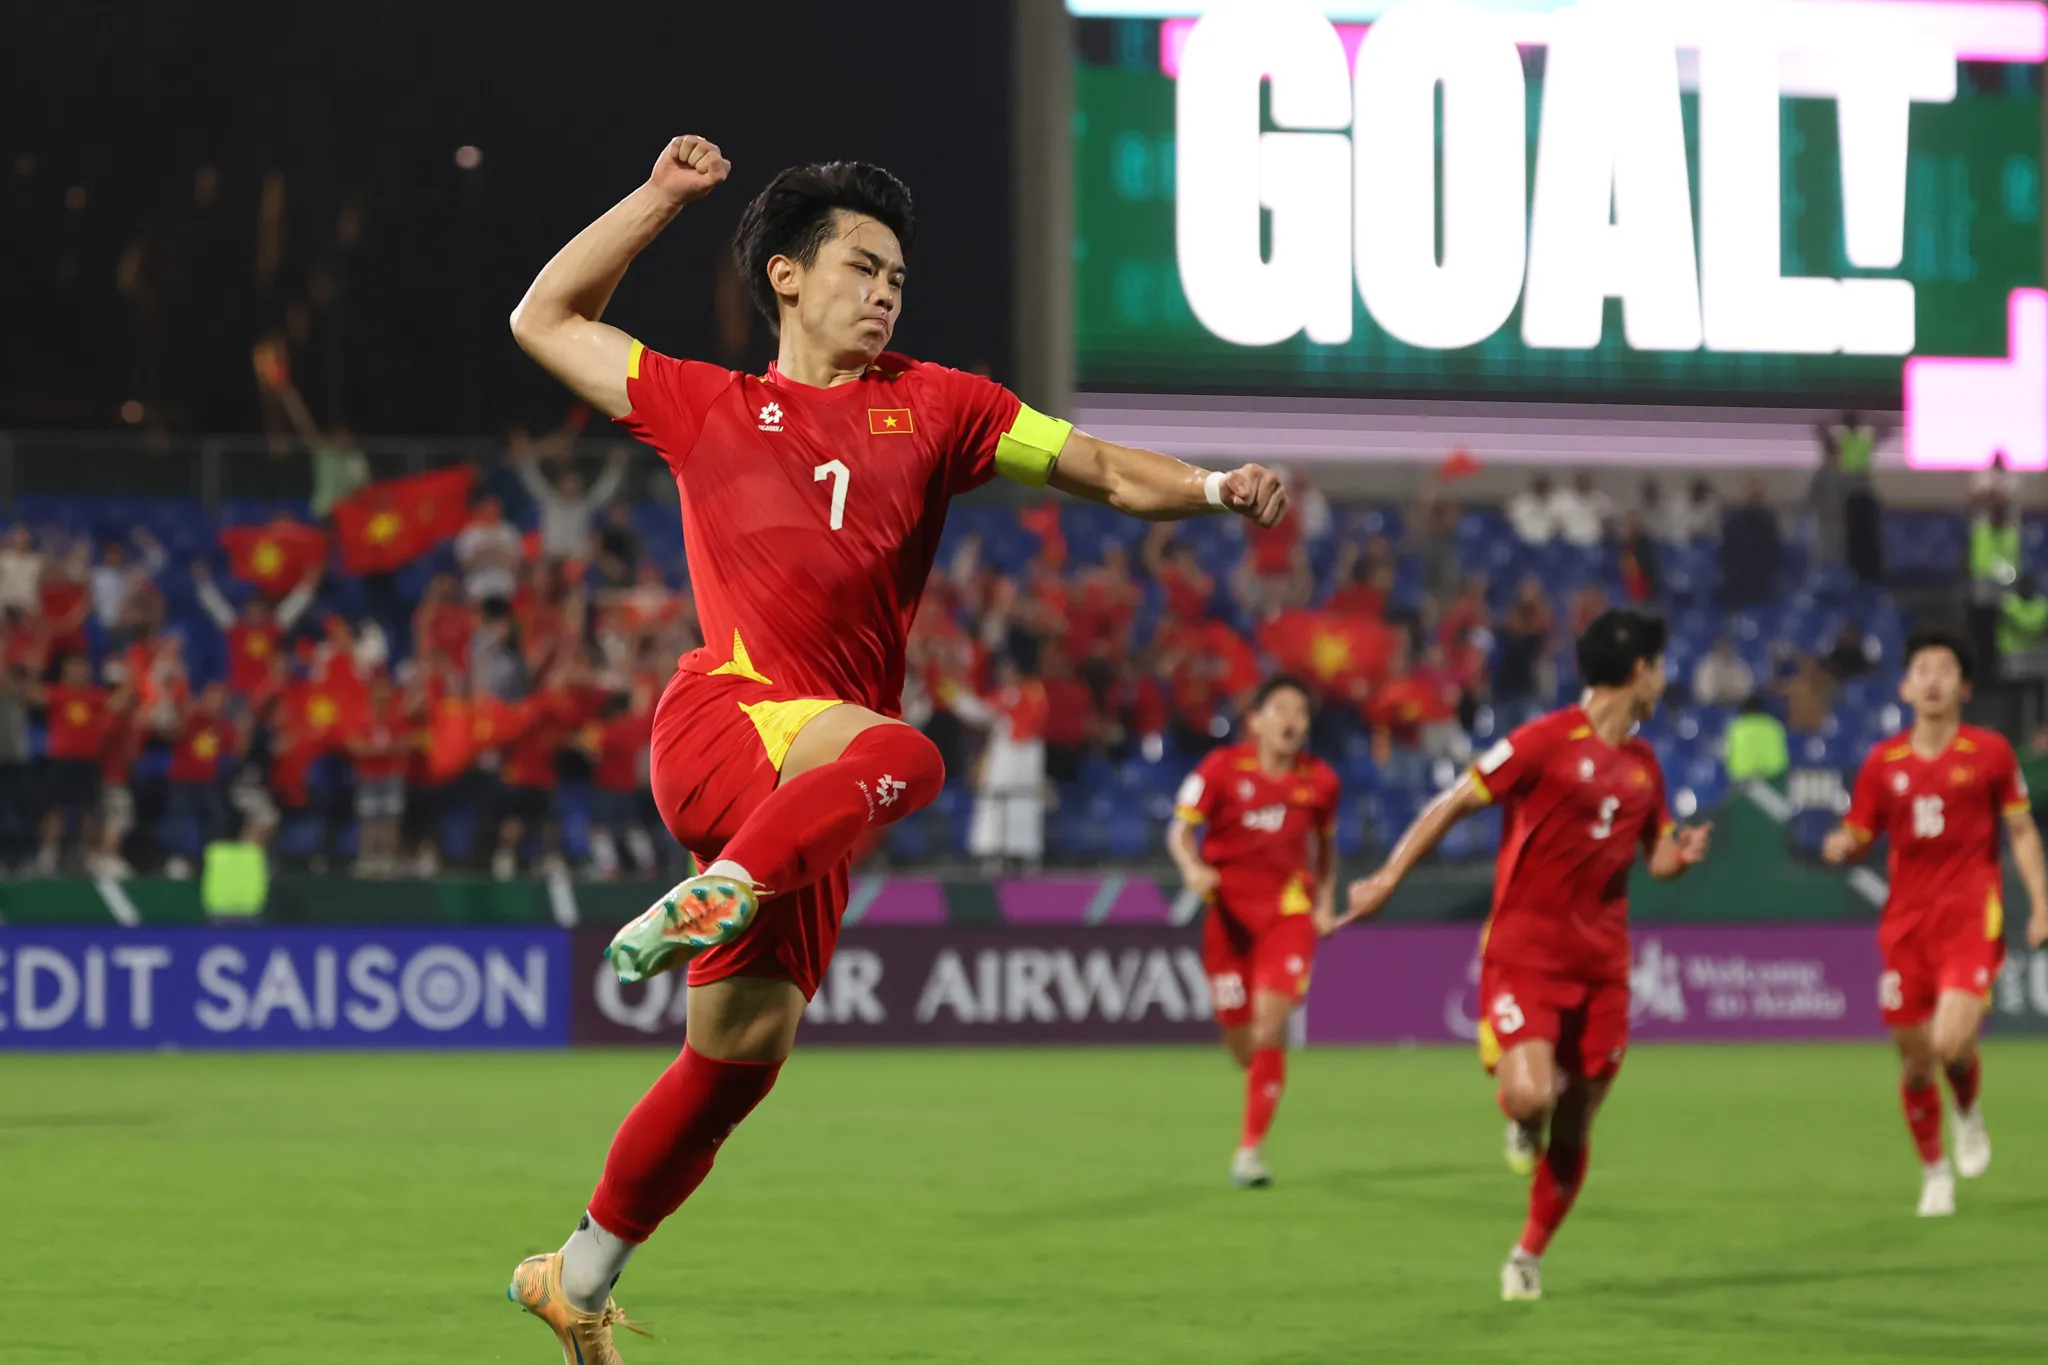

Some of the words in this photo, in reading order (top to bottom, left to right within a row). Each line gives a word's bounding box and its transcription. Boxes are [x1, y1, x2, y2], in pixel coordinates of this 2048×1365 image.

[1174, 0, 1917, 355] GOAL!
[813, 458, 850, 531] 7
[0, 945, 170, 1031] DIT
[195, 945, 548, 1031] SAISON
[917, 947, 1214, 1022] AIRWAY
[1493, 992, 1525, 1034] 5
